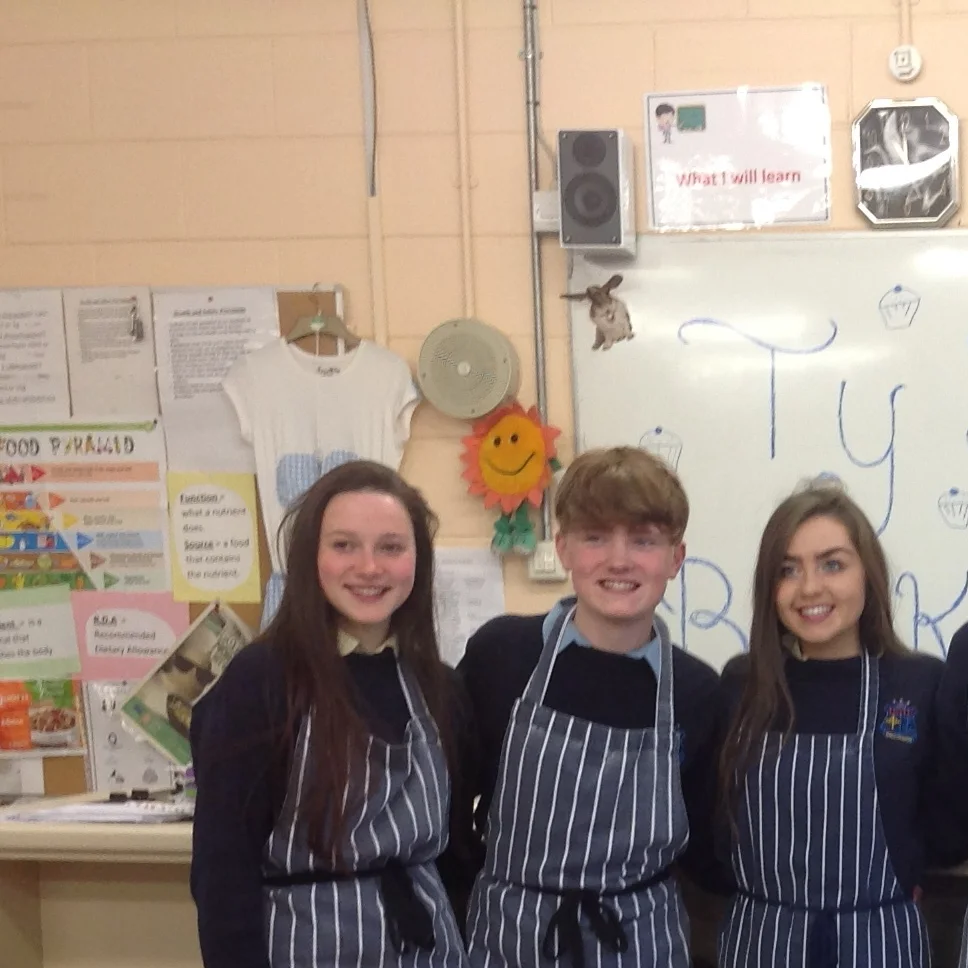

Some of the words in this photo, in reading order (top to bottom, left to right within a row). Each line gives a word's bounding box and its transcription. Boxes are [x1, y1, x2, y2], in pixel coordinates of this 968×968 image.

[676, 171, 717, 186] What
[731, 168, 758, 184] will
[762, 168, 801, 184] learn
